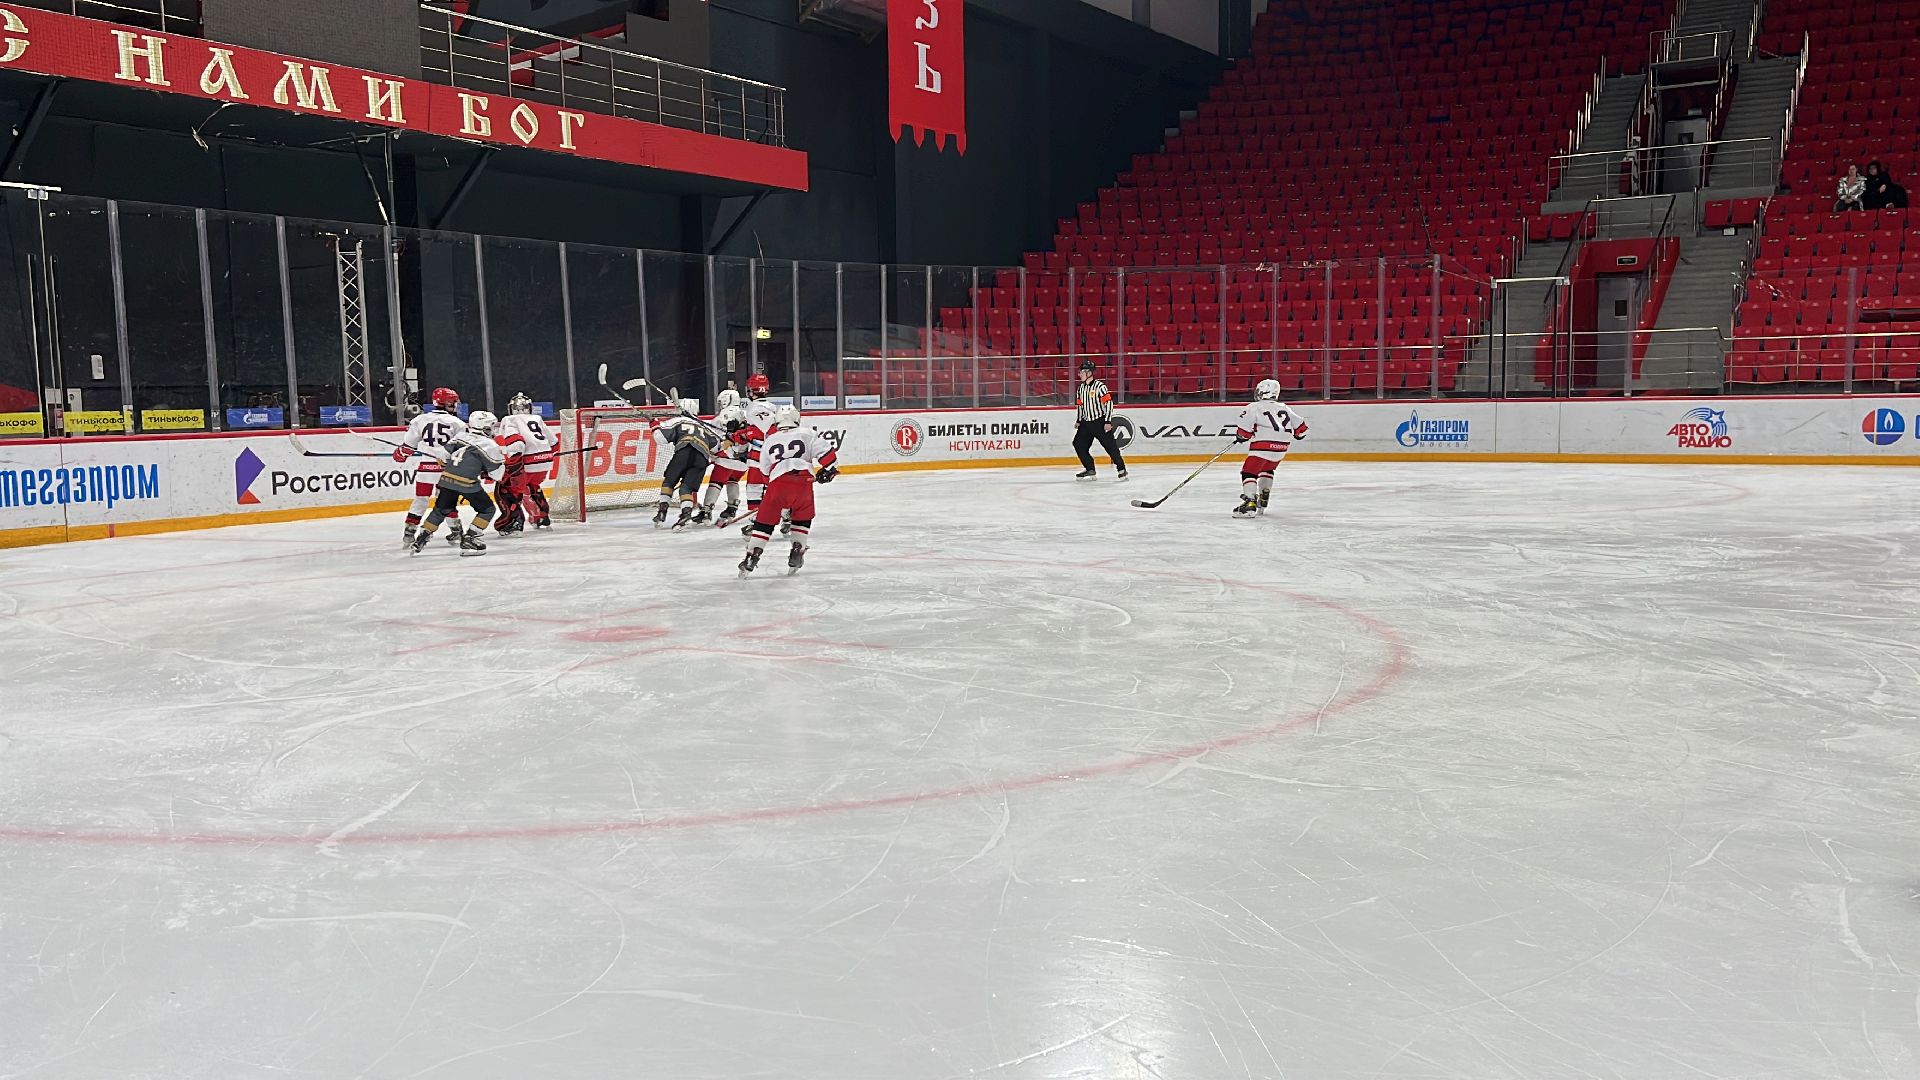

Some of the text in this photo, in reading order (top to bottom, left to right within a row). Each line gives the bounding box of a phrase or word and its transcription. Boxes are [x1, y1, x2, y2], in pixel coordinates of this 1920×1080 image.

[111, 29, 407, 124] НАМИ
[458, 92, 585, 150] БОГ
[527, 420, 546, 441] 9
[928, 419, 1049, 437] БИЛЕТЫ ОНЛАЙН
[1263, 410, 1292, 433] 12
[1420, 420, 1469, 433] ГАЗПРОМ
[1666, 423, 1709, 436] АВТО
[421, 422, 451, 447] 45
[1678, 435, 1732, 448] РАДИО
[768, 439, 806, 461] 32
[949, 439, 1021, 452] HCVITYAZ.RU
[271, 469, 418, 496] Ростелеком
